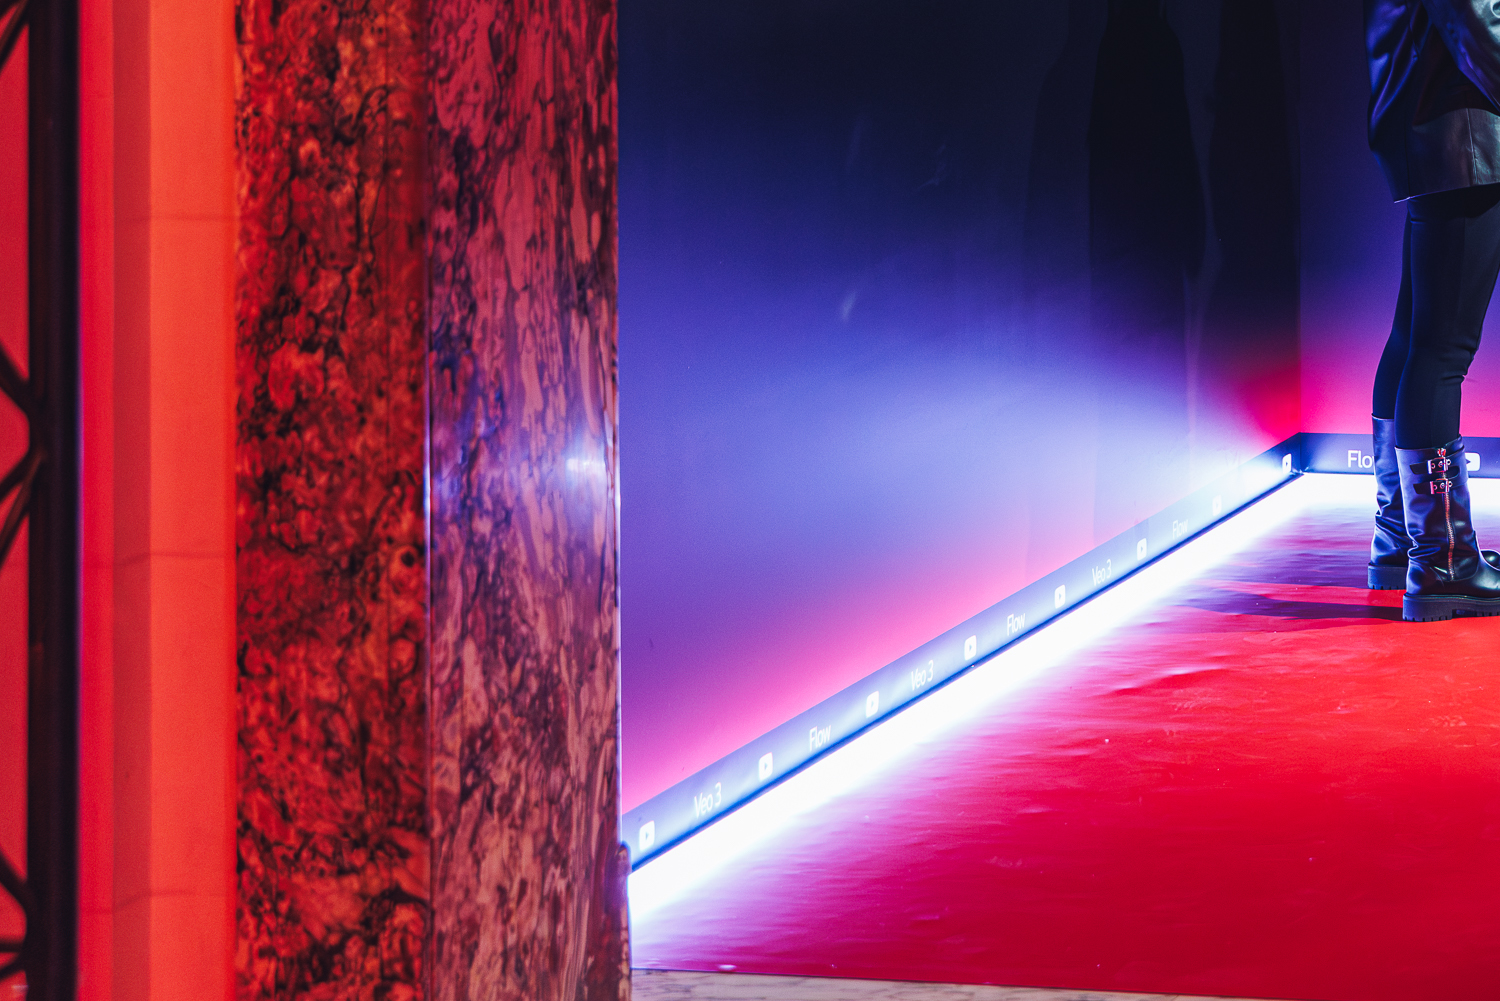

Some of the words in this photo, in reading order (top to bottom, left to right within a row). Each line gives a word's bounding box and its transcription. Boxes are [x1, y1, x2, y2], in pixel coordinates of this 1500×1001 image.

[1347, 450, 1374, 469] Flo
[1092, 566, 1106, 587] Veo
[1106, 558, 1112, 578] 3
[1006, 613, 1026, 636] Flow
[910, 666, 926, 691] Veo
[927, 660, 934, 682] 3
[809, 725, 831, 751] Flow
[694, 793, 713, 818] Veo
[714, 782, 722, 805] 3
